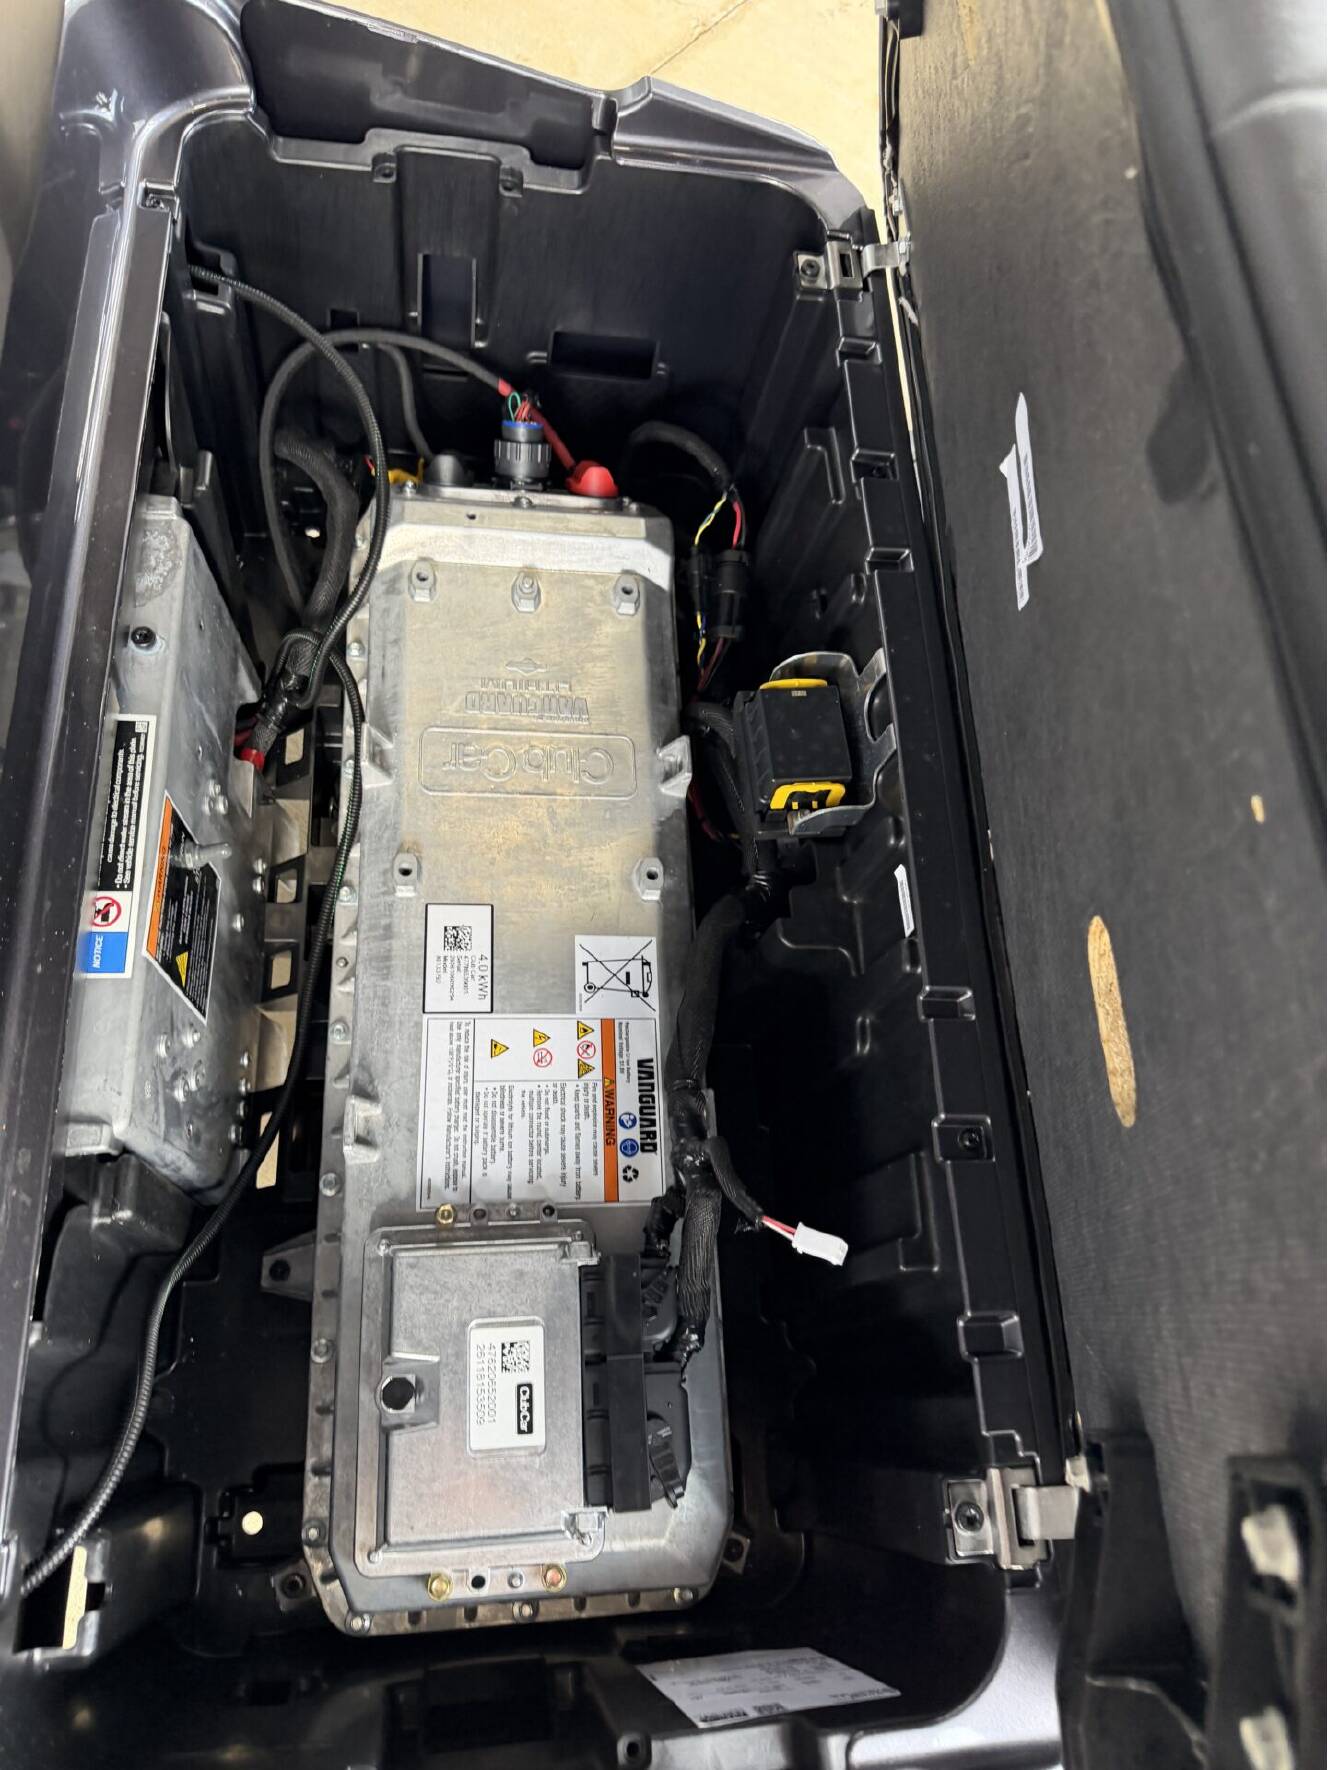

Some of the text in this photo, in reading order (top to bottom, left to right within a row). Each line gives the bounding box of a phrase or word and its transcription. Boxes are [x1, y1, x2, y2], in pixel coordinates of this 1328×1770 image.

[464, 691, 590, 718] VANGUARD
[442, 741, 615, 786] Club Car
[92, 934, 104, 969] NOTICE
[478, 954, 489, 1001] 4.0 kWh
[604, 1089, 616, 1146] WARNING
[637, 1058, 658, 1153] VANGUARD
